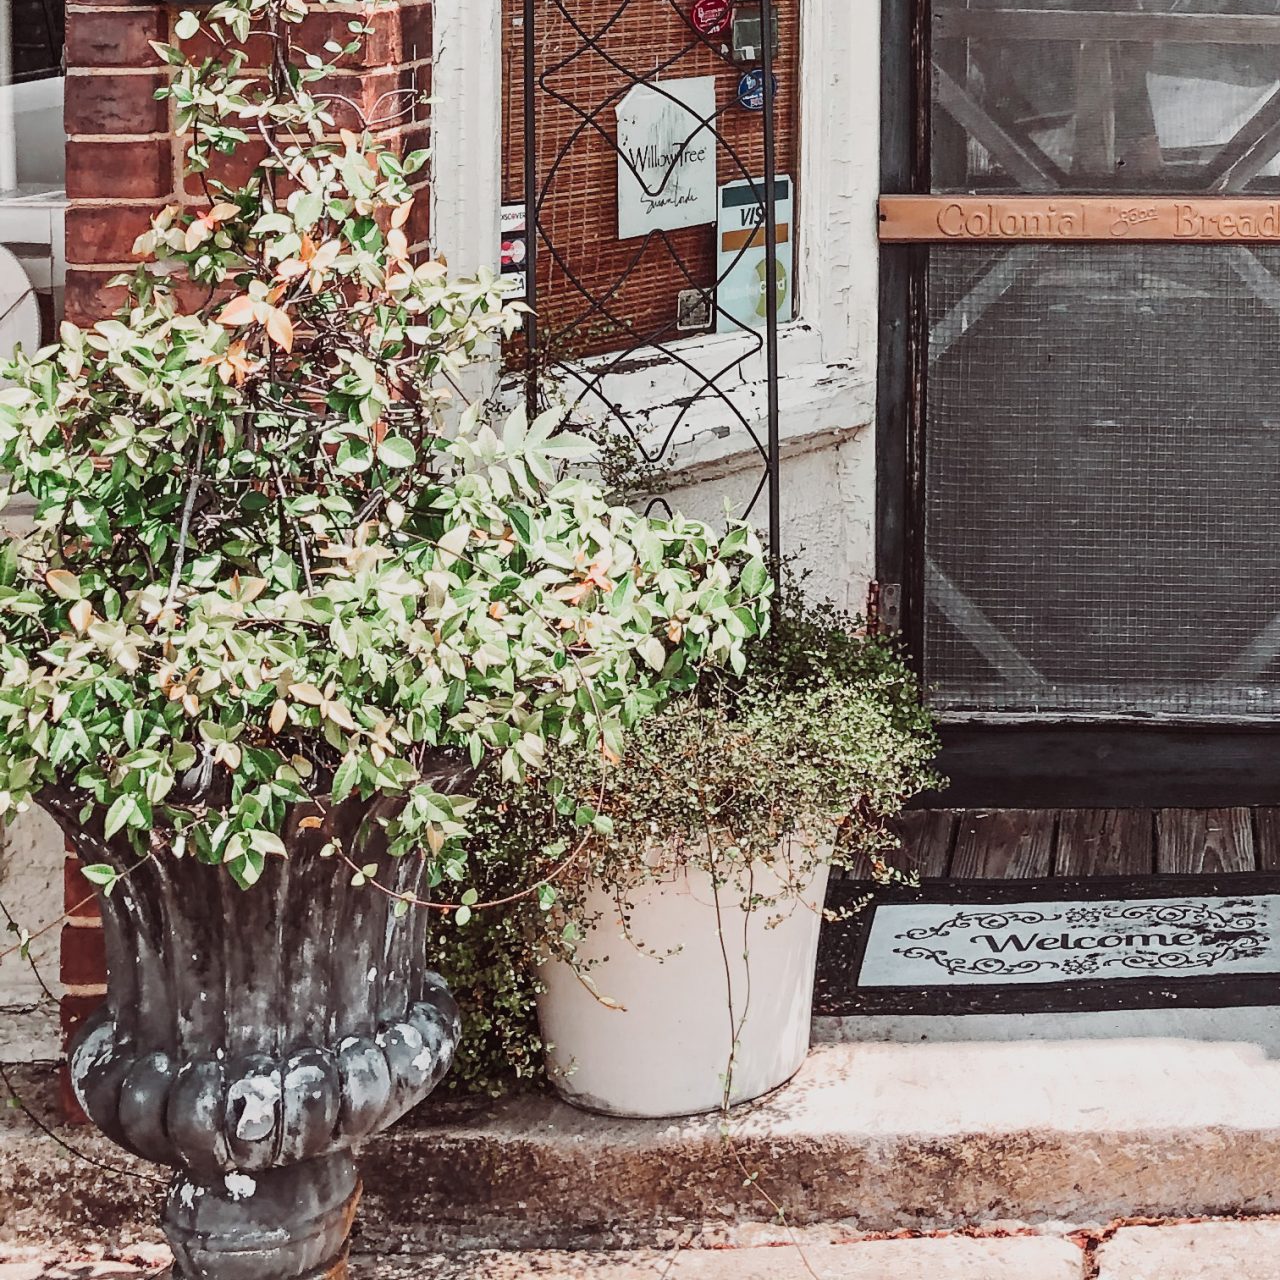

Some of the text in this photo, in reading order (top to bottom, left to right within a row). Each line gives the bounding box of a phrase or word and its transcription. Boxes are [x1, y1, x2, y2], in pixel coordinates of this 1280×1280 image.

[628, 142, 706, 172] Willow Tree
[740, 207, 766, 226] VIS
[936, 203, 1092, 237] Colonial
[1173, 204, 1280, 238] Bread
[970, 932, 1195, 953] Welcome
